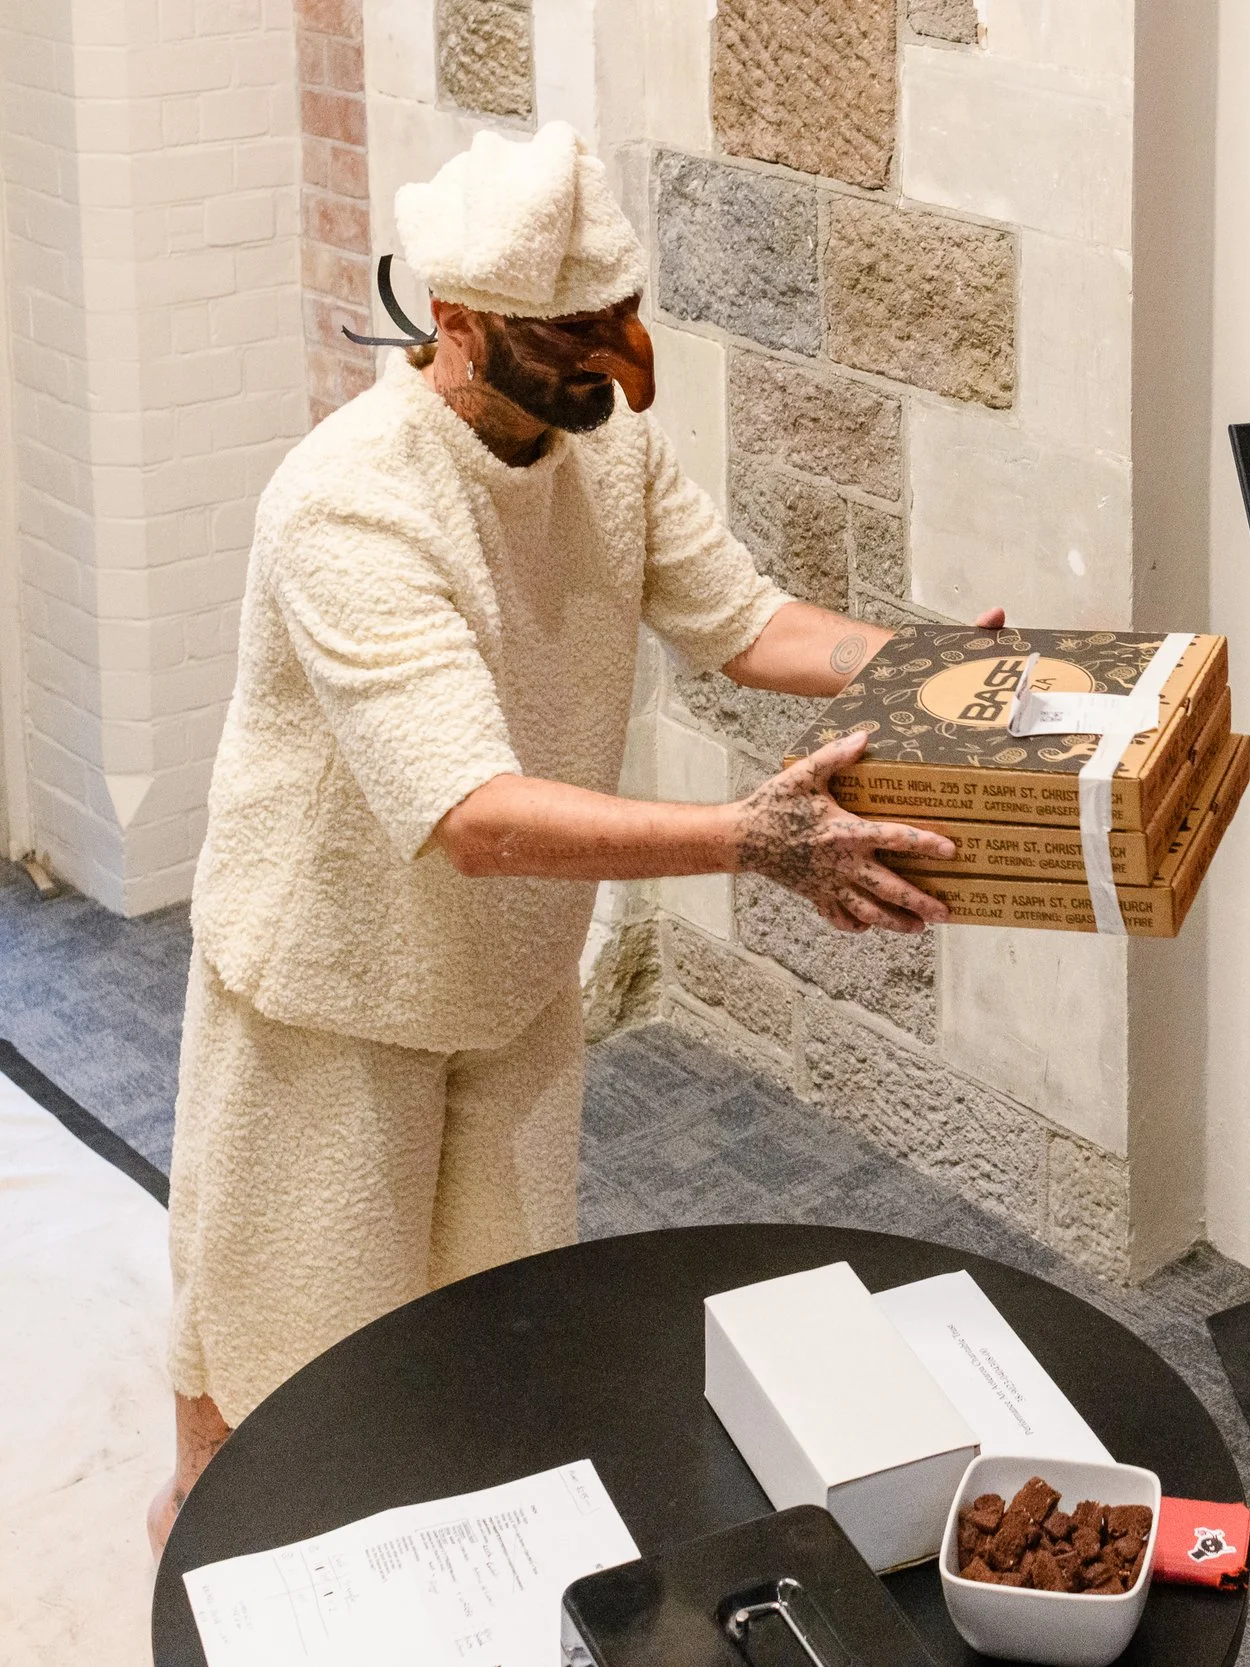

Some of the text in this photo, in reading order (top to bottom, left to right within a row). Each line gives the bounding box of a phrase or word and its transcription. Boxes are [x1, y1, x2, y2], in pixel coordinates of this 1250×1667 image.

[868, 777, 903, 791] LITTLE
[940, 782, 960, 794] 255
[964, 784, 977, 795] ST
[982, 785, 1015, 797] ASAPH
[1042, 789, 1123, 805] CHRISTCH
[985, 801, 1032, 814] CATERING:
[967, 838, 981, 848] ST
[986, 839, 1018, 851] ASAPH
[1045, 843, 1126, 858] CHRISTCH
[988, 855, 1035, 868] CATERING:
[969, 892, 989, 904] 255
[993, 894, 1007, 905] ST
[1012, 895, 1045, 908] ASAPH
[1014, 910, 1062, 923] CATERING:
